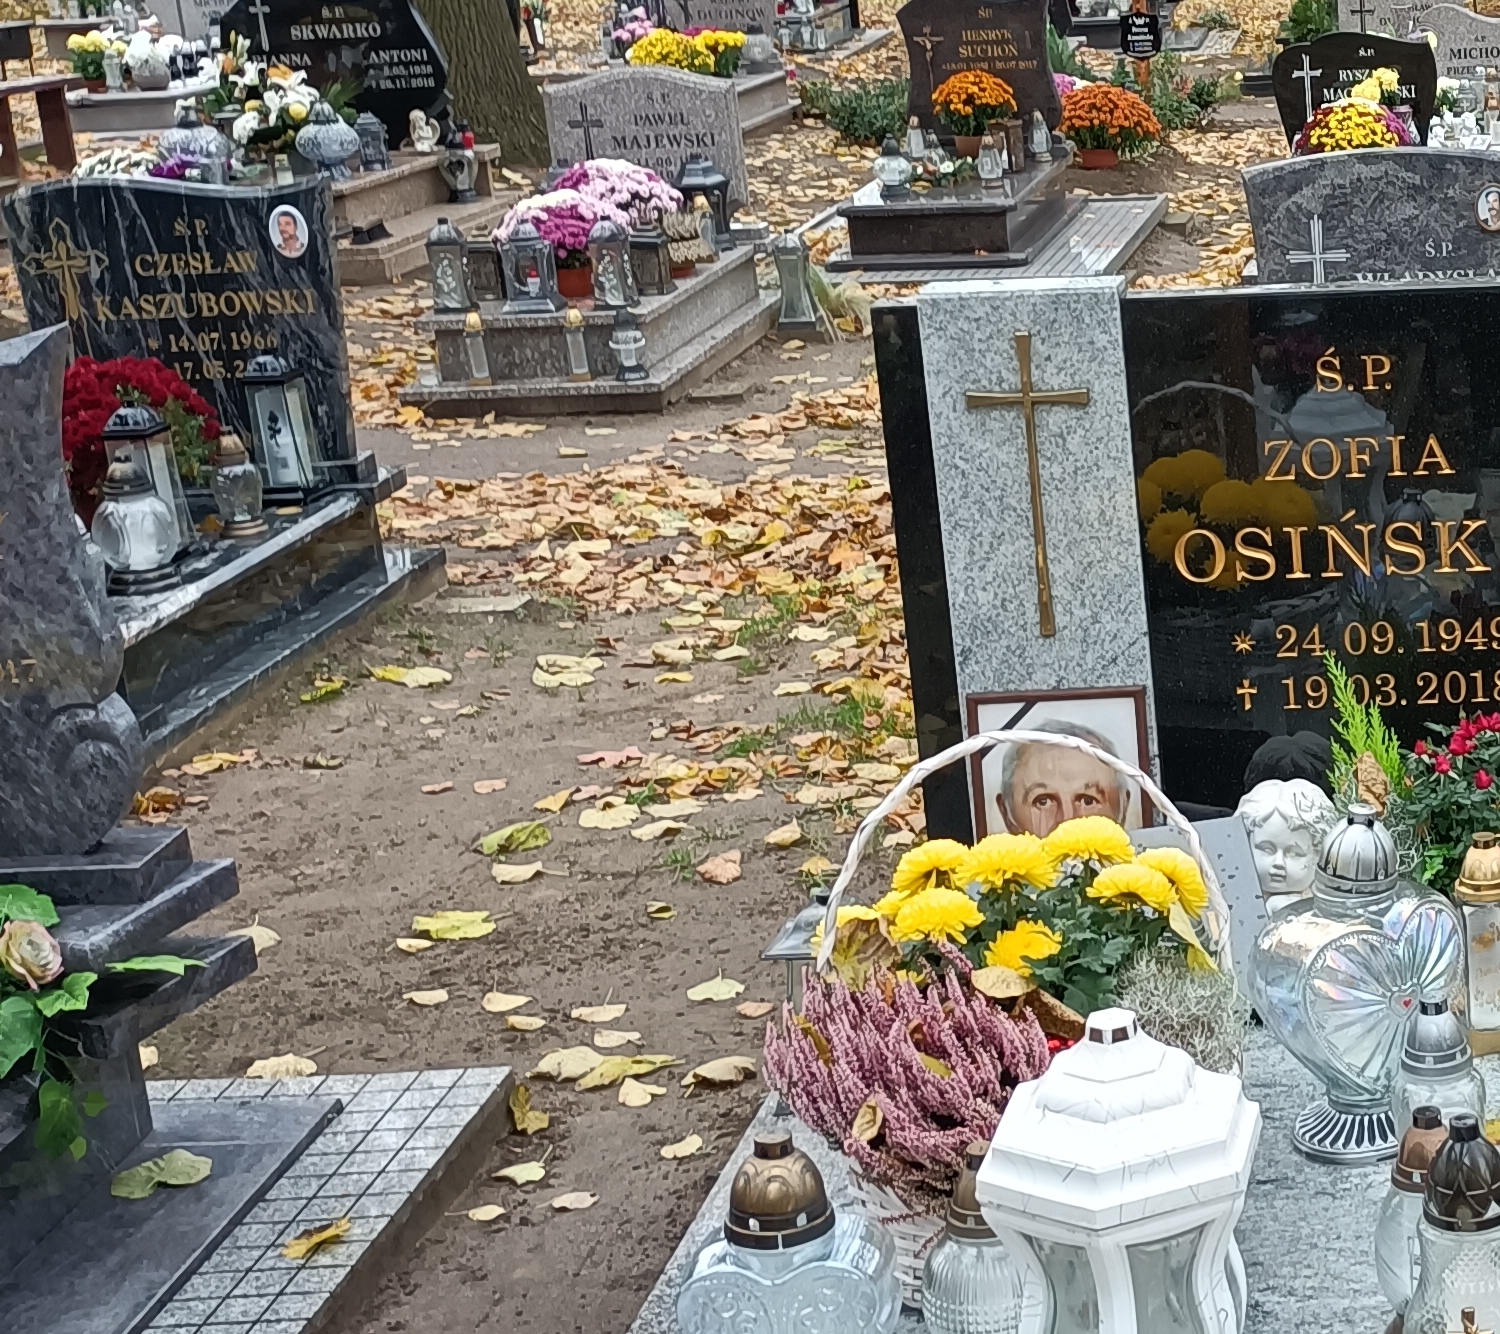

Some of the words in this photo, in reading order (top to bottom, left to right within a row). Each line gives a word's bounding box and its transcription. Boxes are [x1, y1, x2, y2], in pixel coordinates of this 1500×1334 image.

[290, 22, 382, 41] SKWARKO
[961, 28, 1013, 42] HENRYK
[368, 48, 428, 64] ANTONI
[611, 132, 716, 151] MAJEWSKI
[134, 250, 259, 278] CZESŁAW
[95, 288, 318, 322] KASZUBOWSKI
[1315, 346, 1393, 393] Ś.P.
[1263, 433, 1457, 482] ZOFIA
